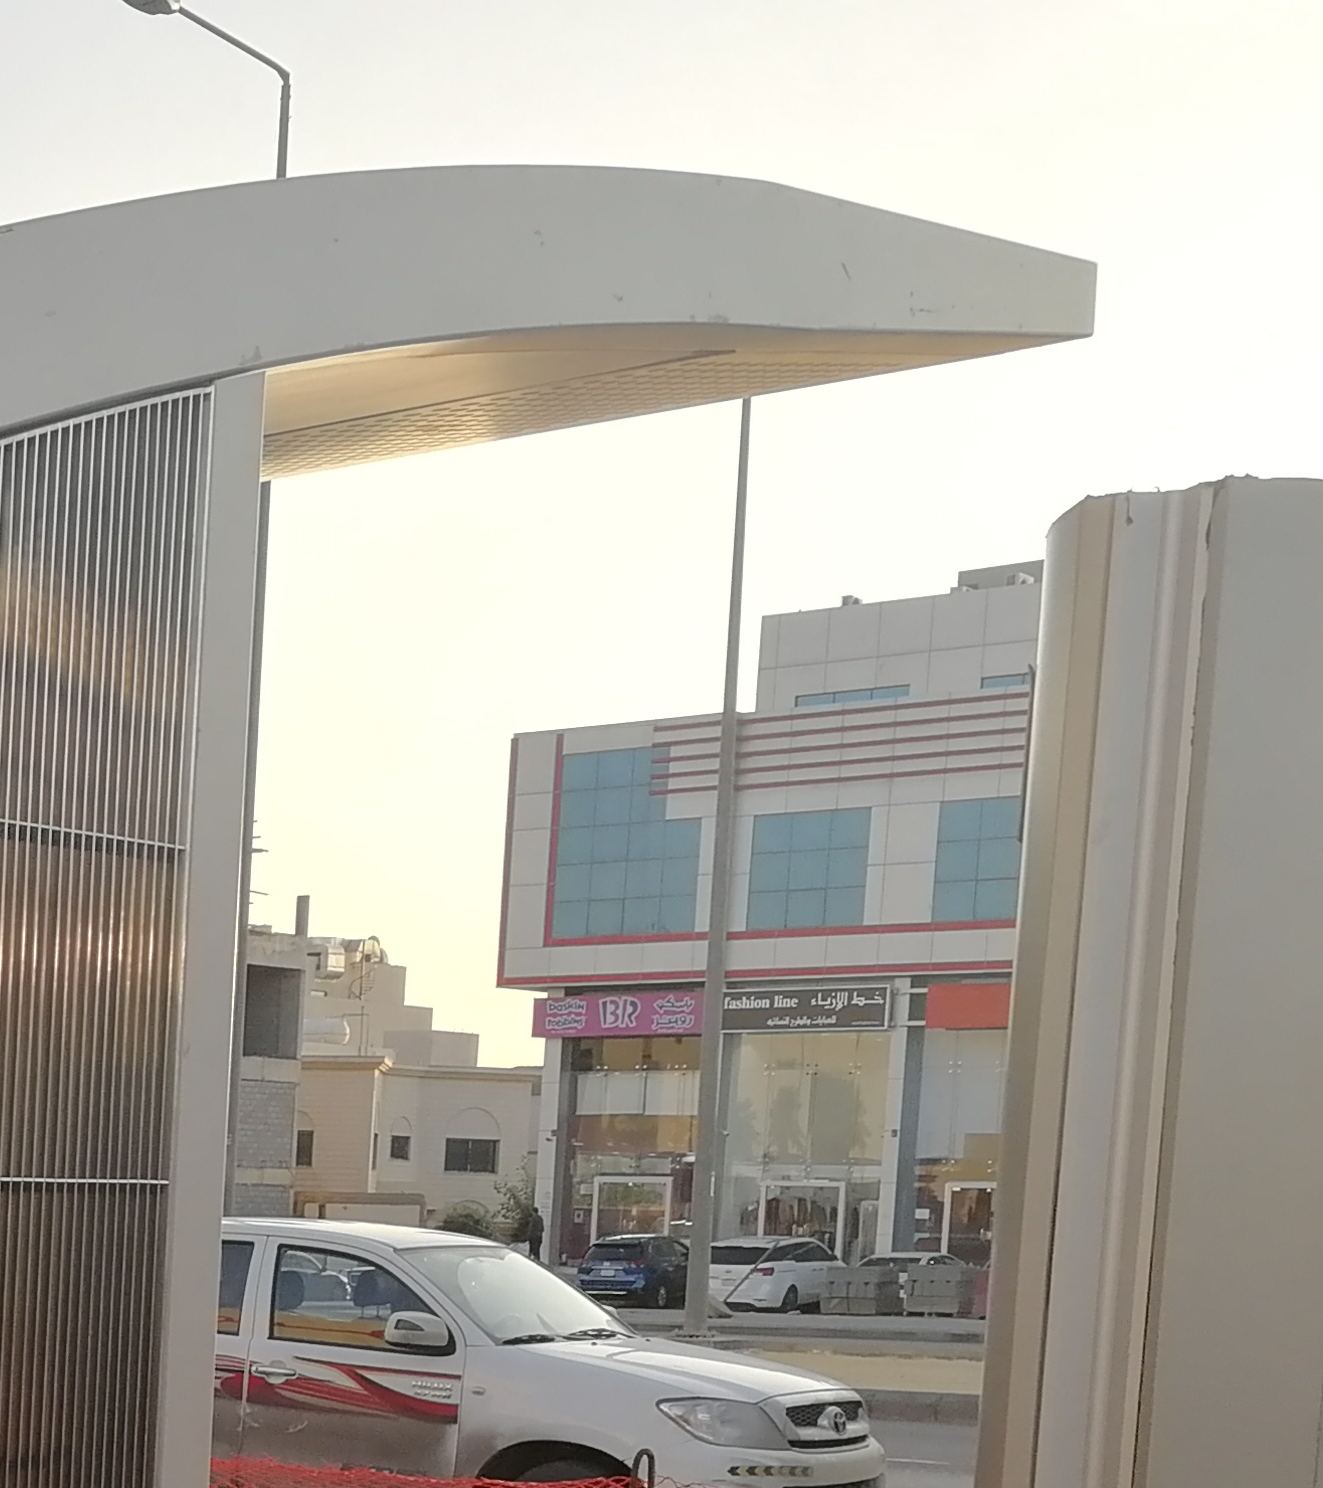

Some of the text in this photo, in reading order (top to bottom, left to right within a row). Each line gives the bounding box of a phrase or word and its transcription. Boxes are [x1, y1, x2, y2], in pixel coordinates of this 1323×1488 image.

[724, 995, 798, 1009] fashion line
[851, 991, 884, 1006] خط
